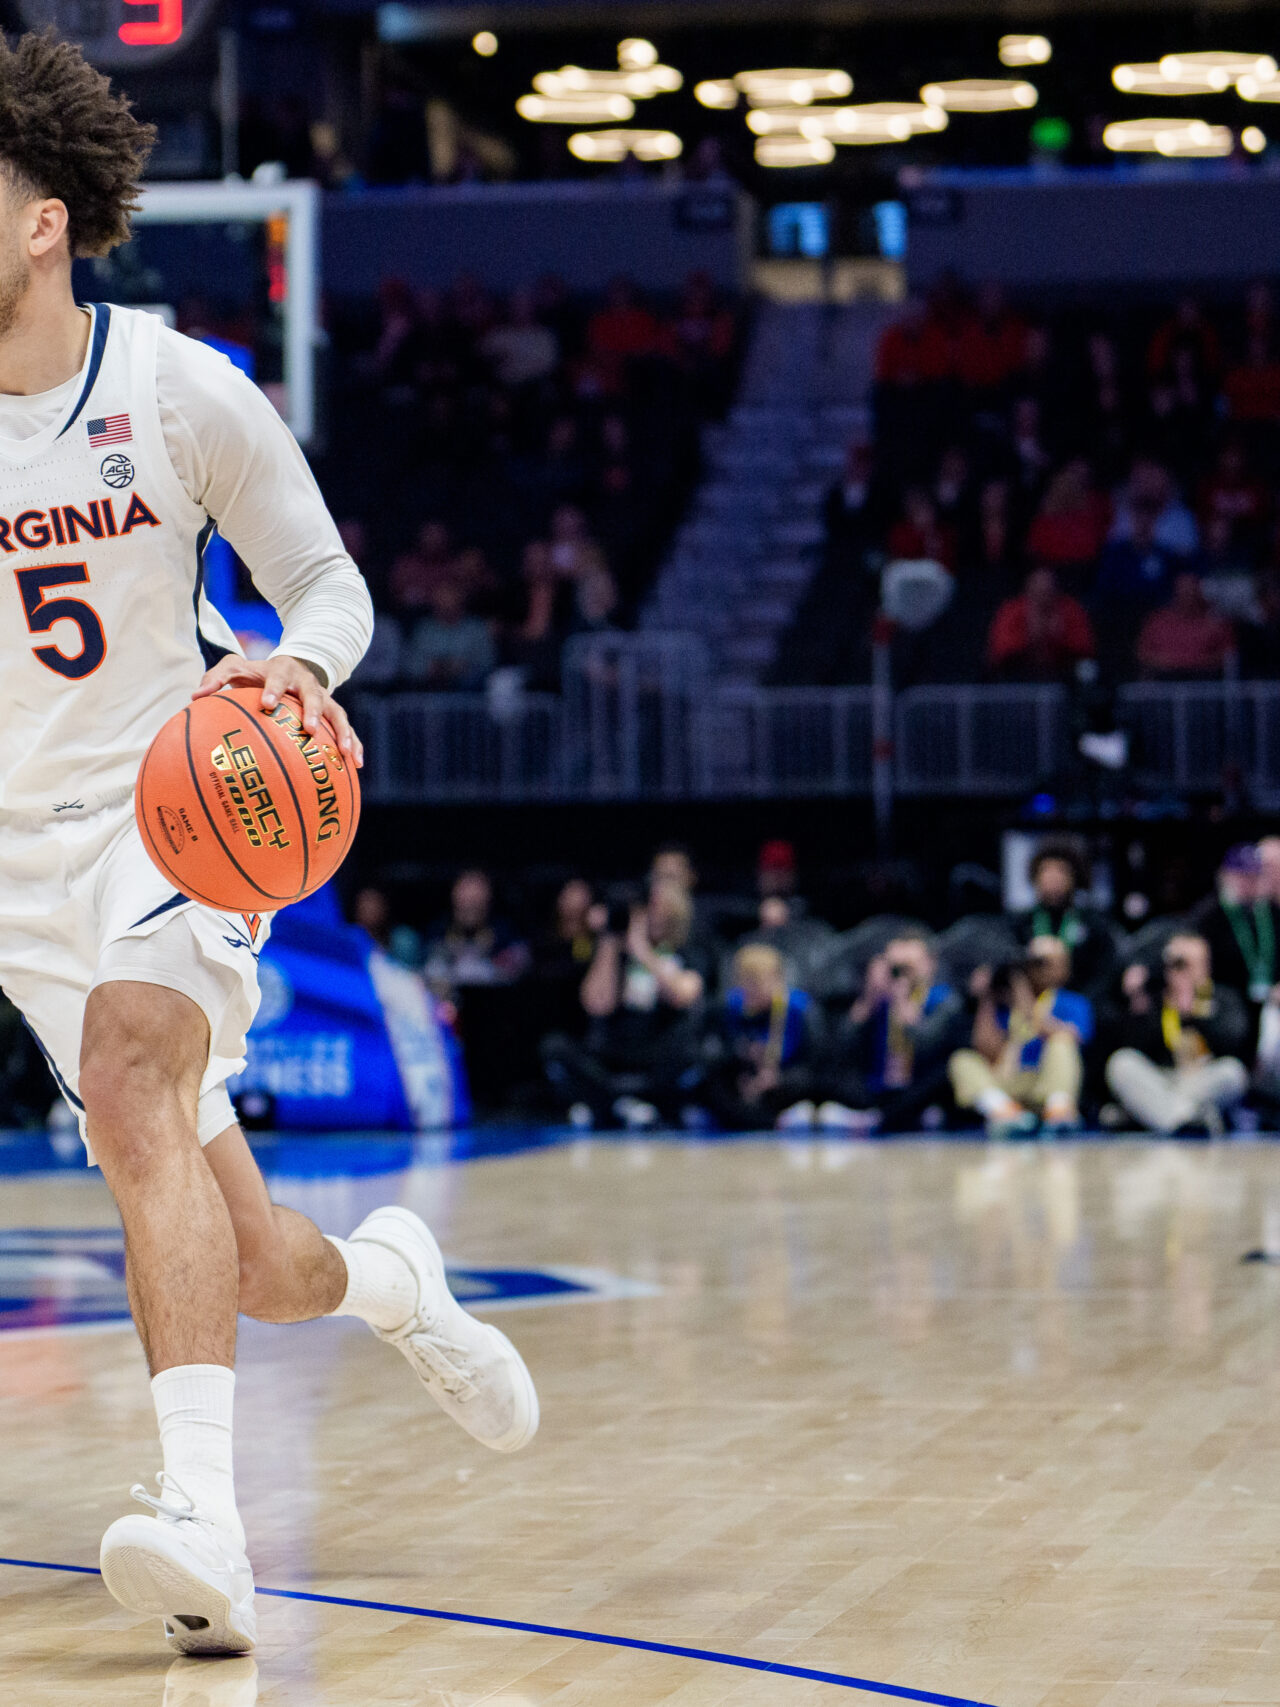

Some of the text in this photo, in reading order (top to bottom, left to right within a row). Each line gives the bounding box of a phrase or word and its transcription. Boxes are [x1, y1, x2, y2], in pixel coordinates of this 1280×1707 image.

[105, 462, 132, 475] ACC
[14, 562, 107, 680] 5
[209, 771, 226, 799] OFFICIAL
[221, 800, 235, 819] GAME
[222, 728, 290, 851] LEGACY
[223, 774, 263, 848] 1000
